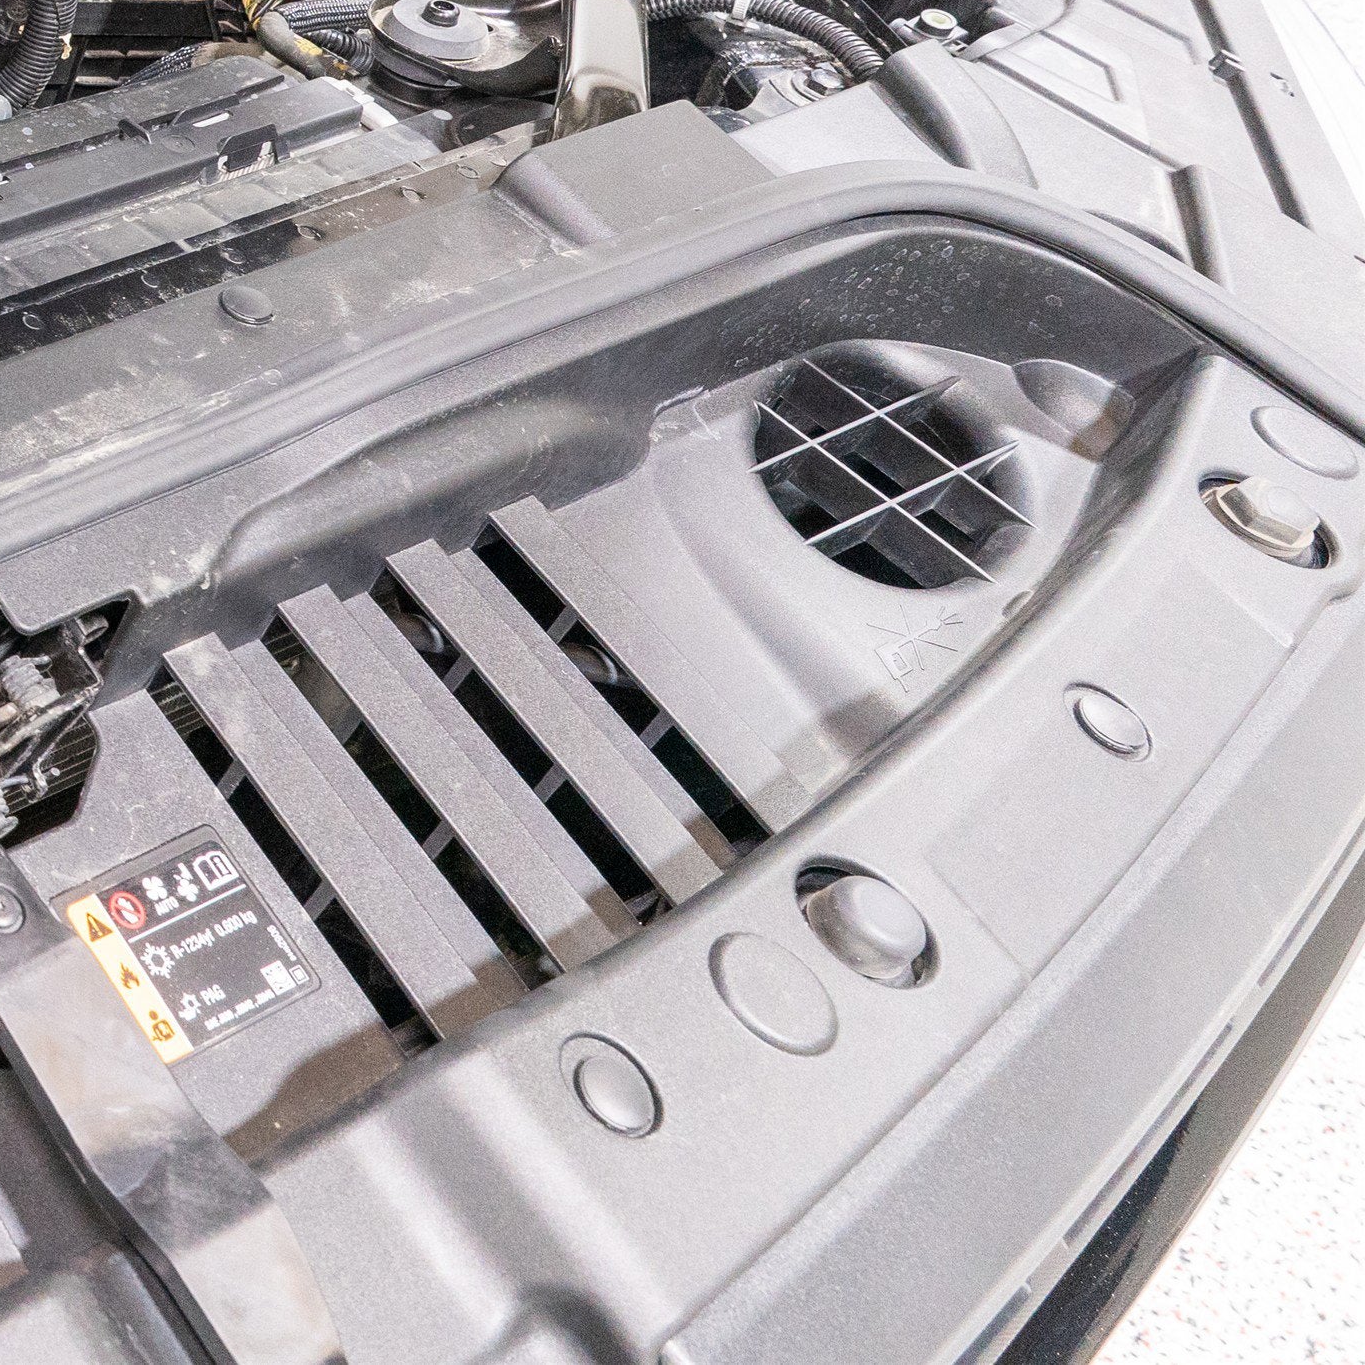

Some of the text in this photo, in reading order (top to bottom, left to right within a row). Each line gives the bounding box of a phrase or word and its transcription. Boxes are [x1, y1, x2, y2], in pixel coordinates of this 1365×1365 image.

[154, 896, 180, 916] AUTO
[170, 910, 258, 959] R-1234yf 0.600 kg
[200, 984, 226, 1006] PAG
